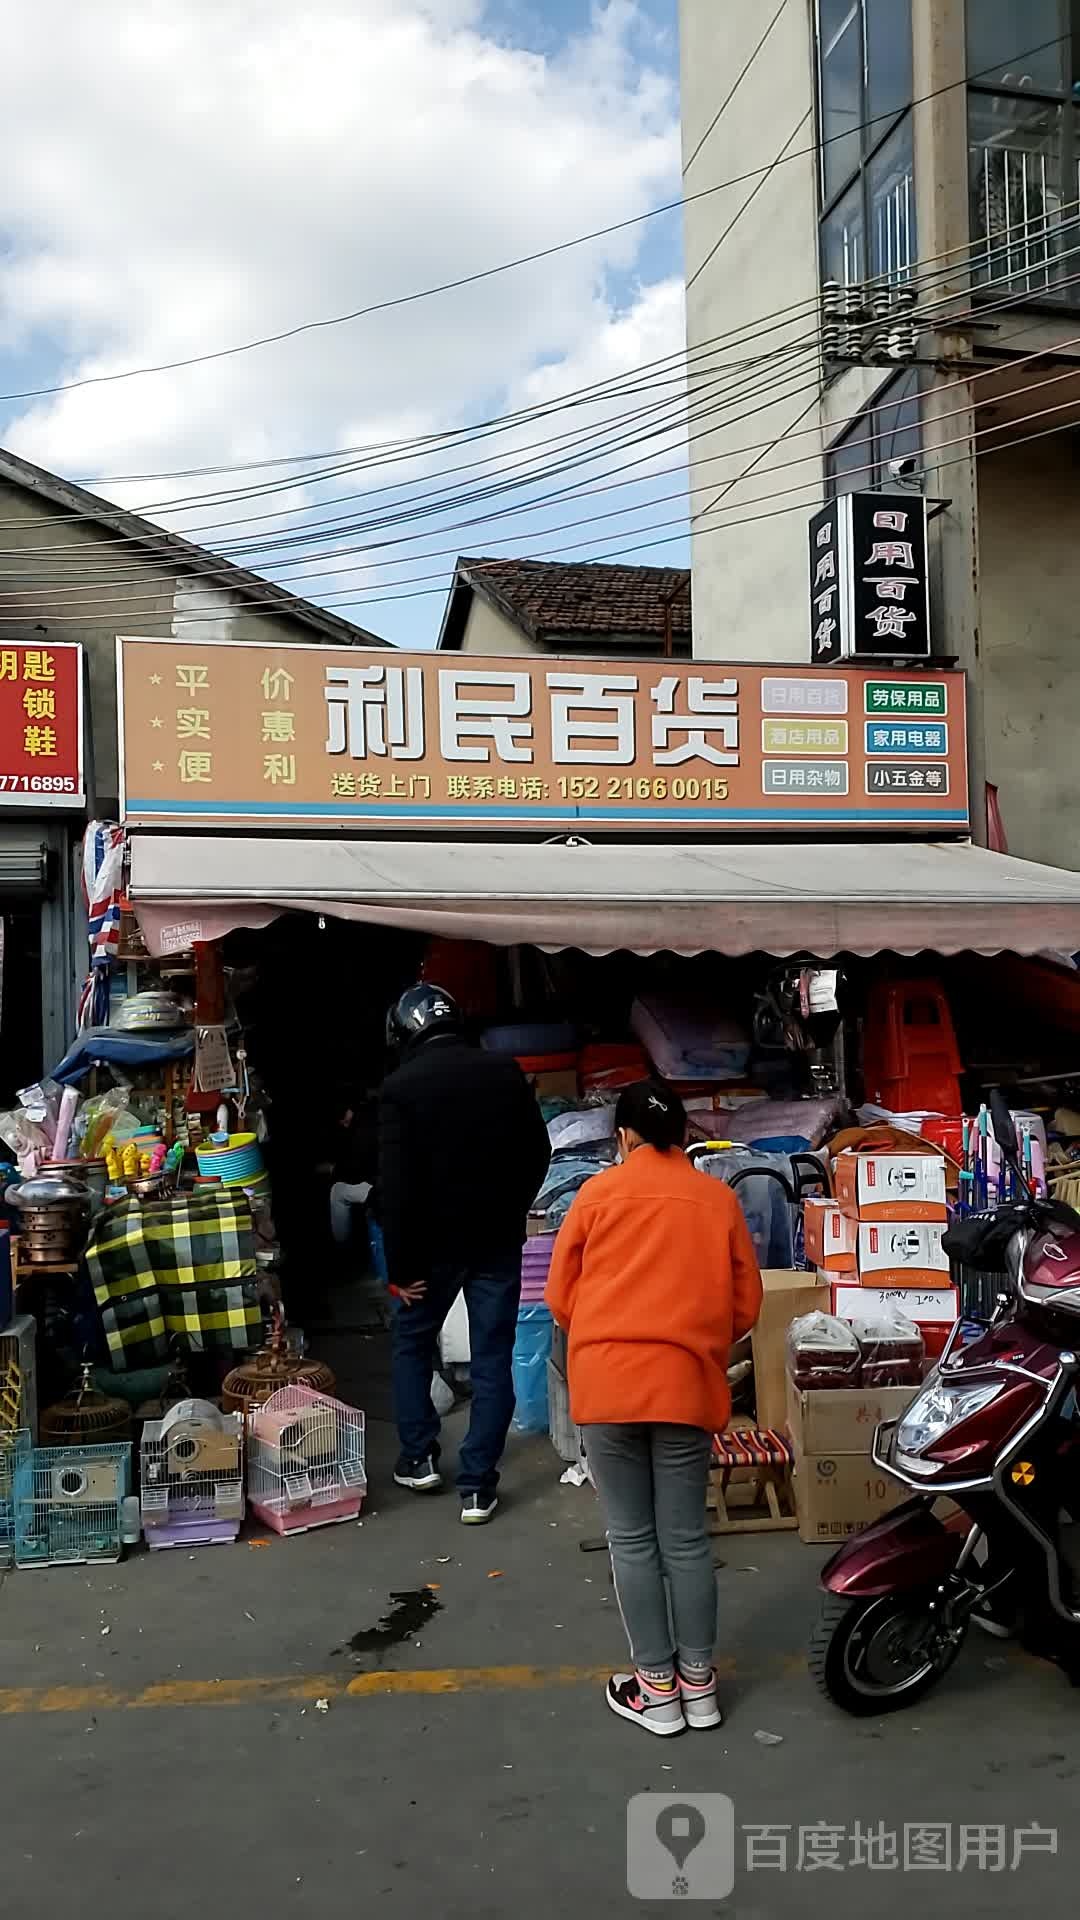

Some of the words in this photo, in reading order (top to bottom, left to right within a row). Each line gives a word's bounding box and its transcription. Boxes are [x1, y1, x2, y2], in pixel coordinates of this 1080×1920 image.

[862, 511, 919, 638] 日用百货
[814, 522, 837, 654] 日用百货
[771, 687, 840, 705] 日用百货
[872, 689, 940, 708] 劳保用品
[325, 666, 739, 765] 利民百货
[770, 727, 839, 745] 酒店用品
[873, 730, 941, 748] 家用电器
[331, 773, 431, 799] 送货上门
[771, 768, 841, 786] 日用杂物
[873, 769, 942, 787] 小五金等
